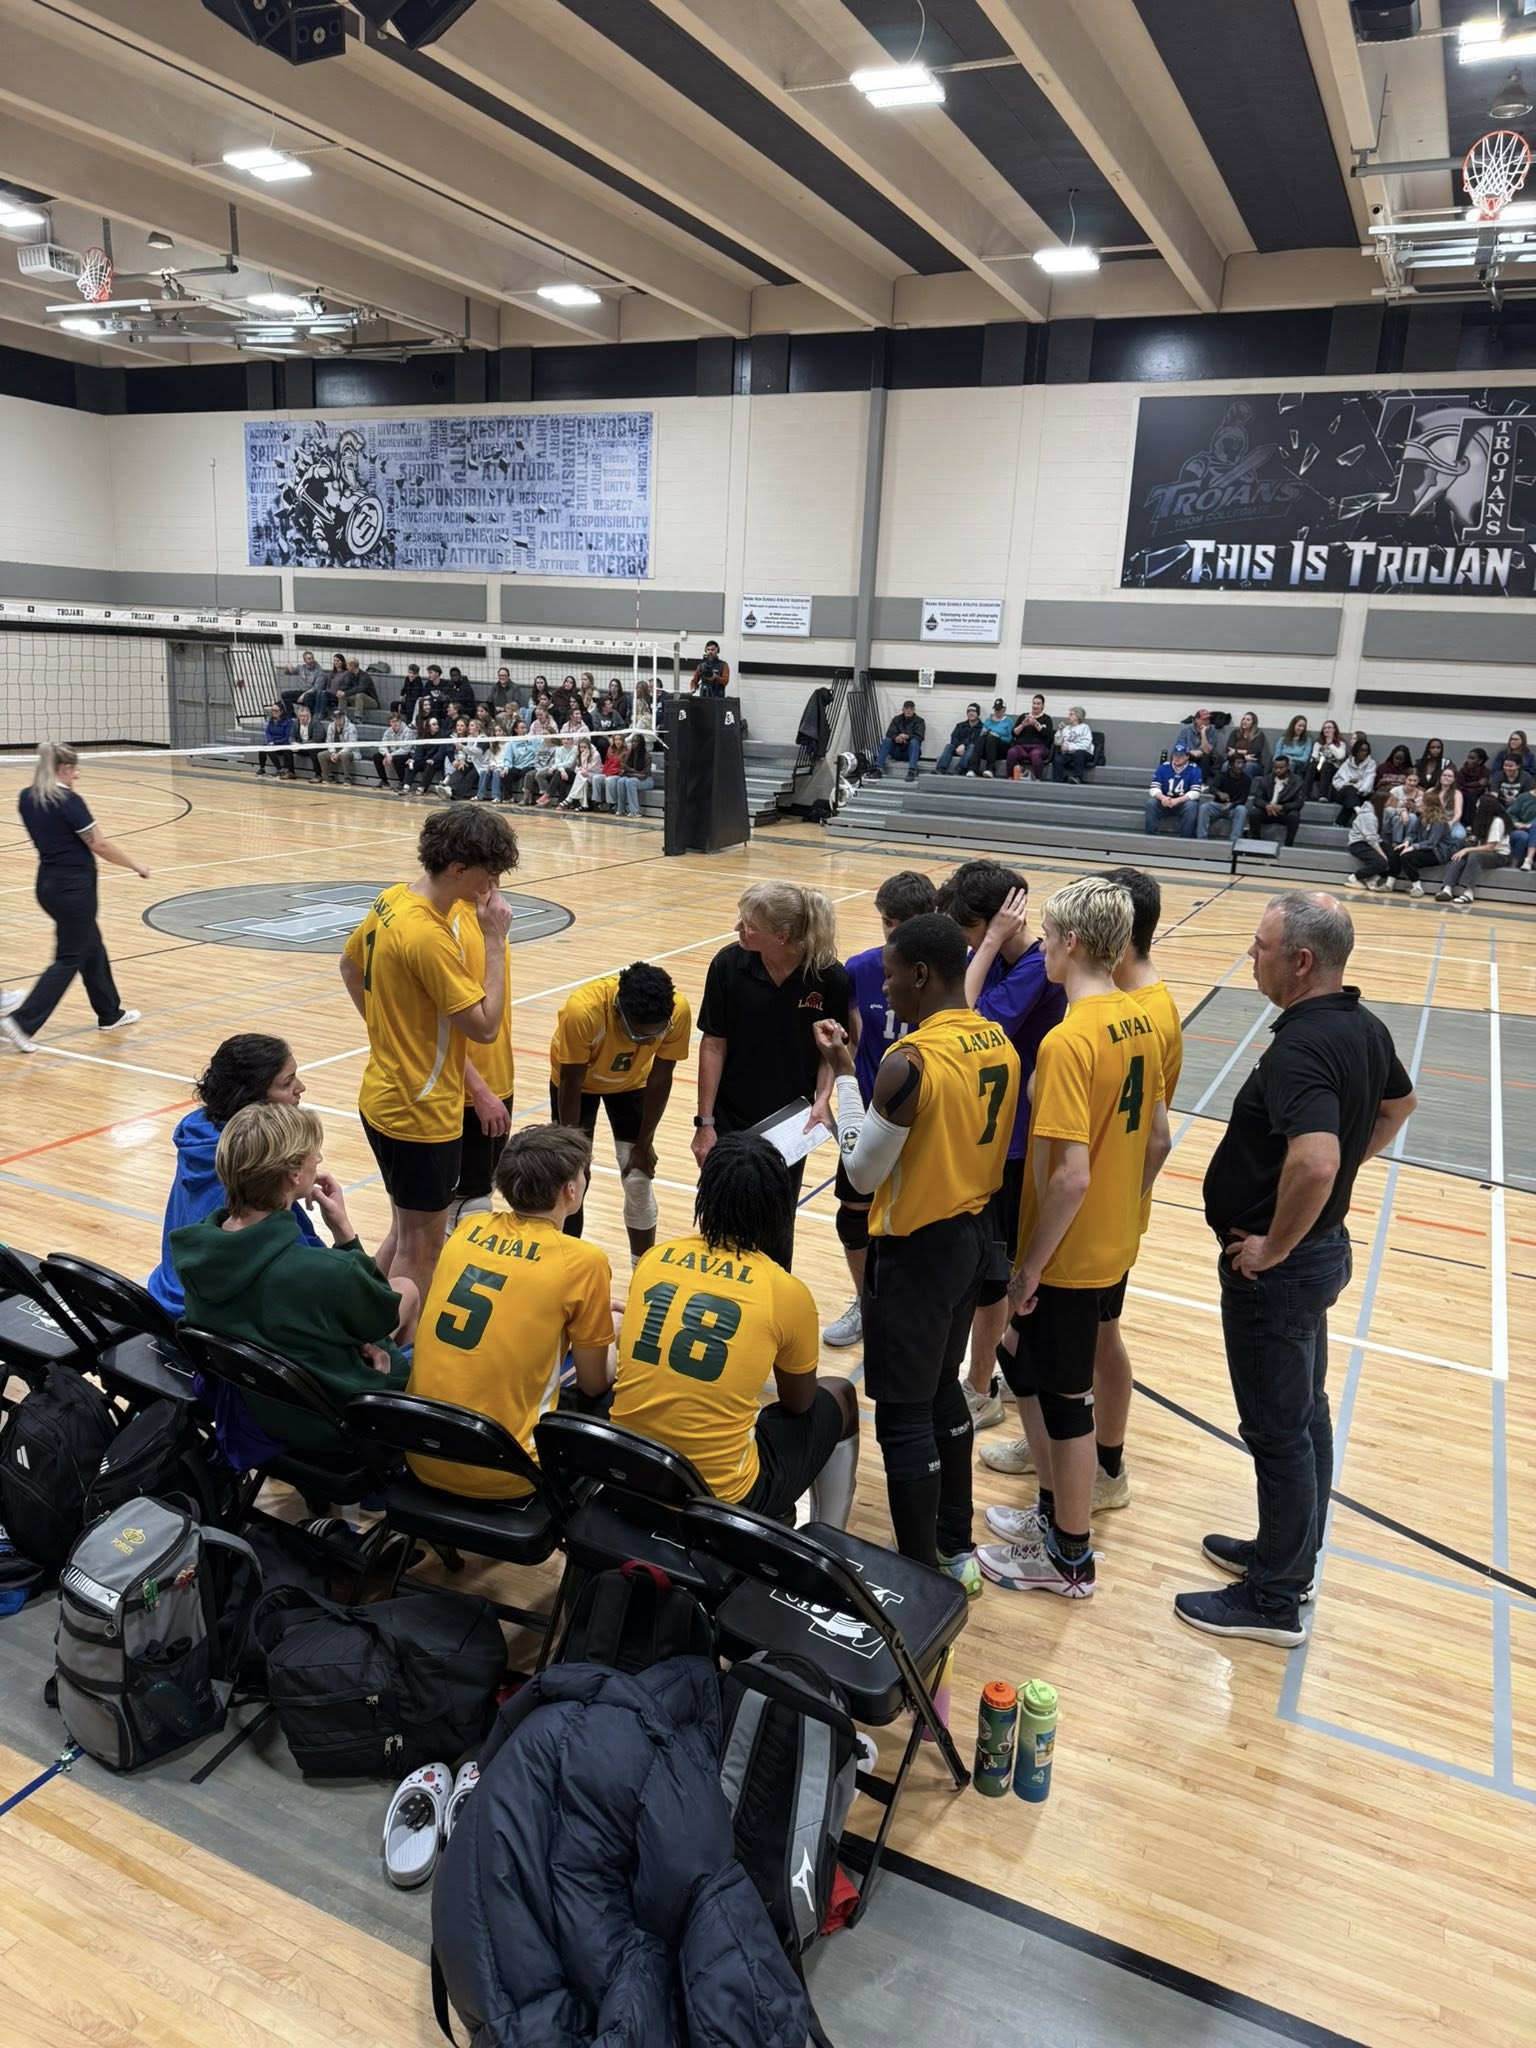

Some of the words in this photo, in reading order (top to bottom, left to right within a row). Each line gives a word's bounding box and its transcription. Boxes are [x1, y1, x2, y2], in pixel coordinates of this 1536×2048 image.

[378, 424, 422, 435] DIVERSITY
[469, 419, 534, 439] RESPECT
[399, 463, 444, 482] SPIRIT
[562, 417, 575, 508] DIVERSITY
[1485, 420, 1512, 536] TROJANS
[400, 488, 514, 507] RESPONSIBILITY
[519, 491, 561, 504] RESPECT
[593, 499, 633, 511] RESPECT
[1149, 480, 1300, 518] TROJANS
[523, 508, 561, 523] SPIRIT
[569, 515, 648, 528] RESPONSIBILITY
[540, 531, 647, 552] ACHIEVEMENT
[450, 548, 511, 565] ATTITUDE
[587, 554, 647, 575] ENERGY
[1185, 540, 1276, 583] THIS
[1290, 541, 1329, 585] IS
[1344, 541, 1513, 587] TROJAN
[57, 609, 84, 617] TROJANS
[131, 612, 155, 621] TROJANS
[1167, 779, 1185, 796] 14
[610, 1052, 634, 1072] 6
[978, 1064, 1008, 1145] 7
[1117, 1056, 1144, 1133] 4
[466, 1225, 541, 1262] LAVAL
[660, 1247, 754, 1284] LAVAL
[435, 1263, 508, 1350] 5
[632, 1281, 742, 1382] 18
